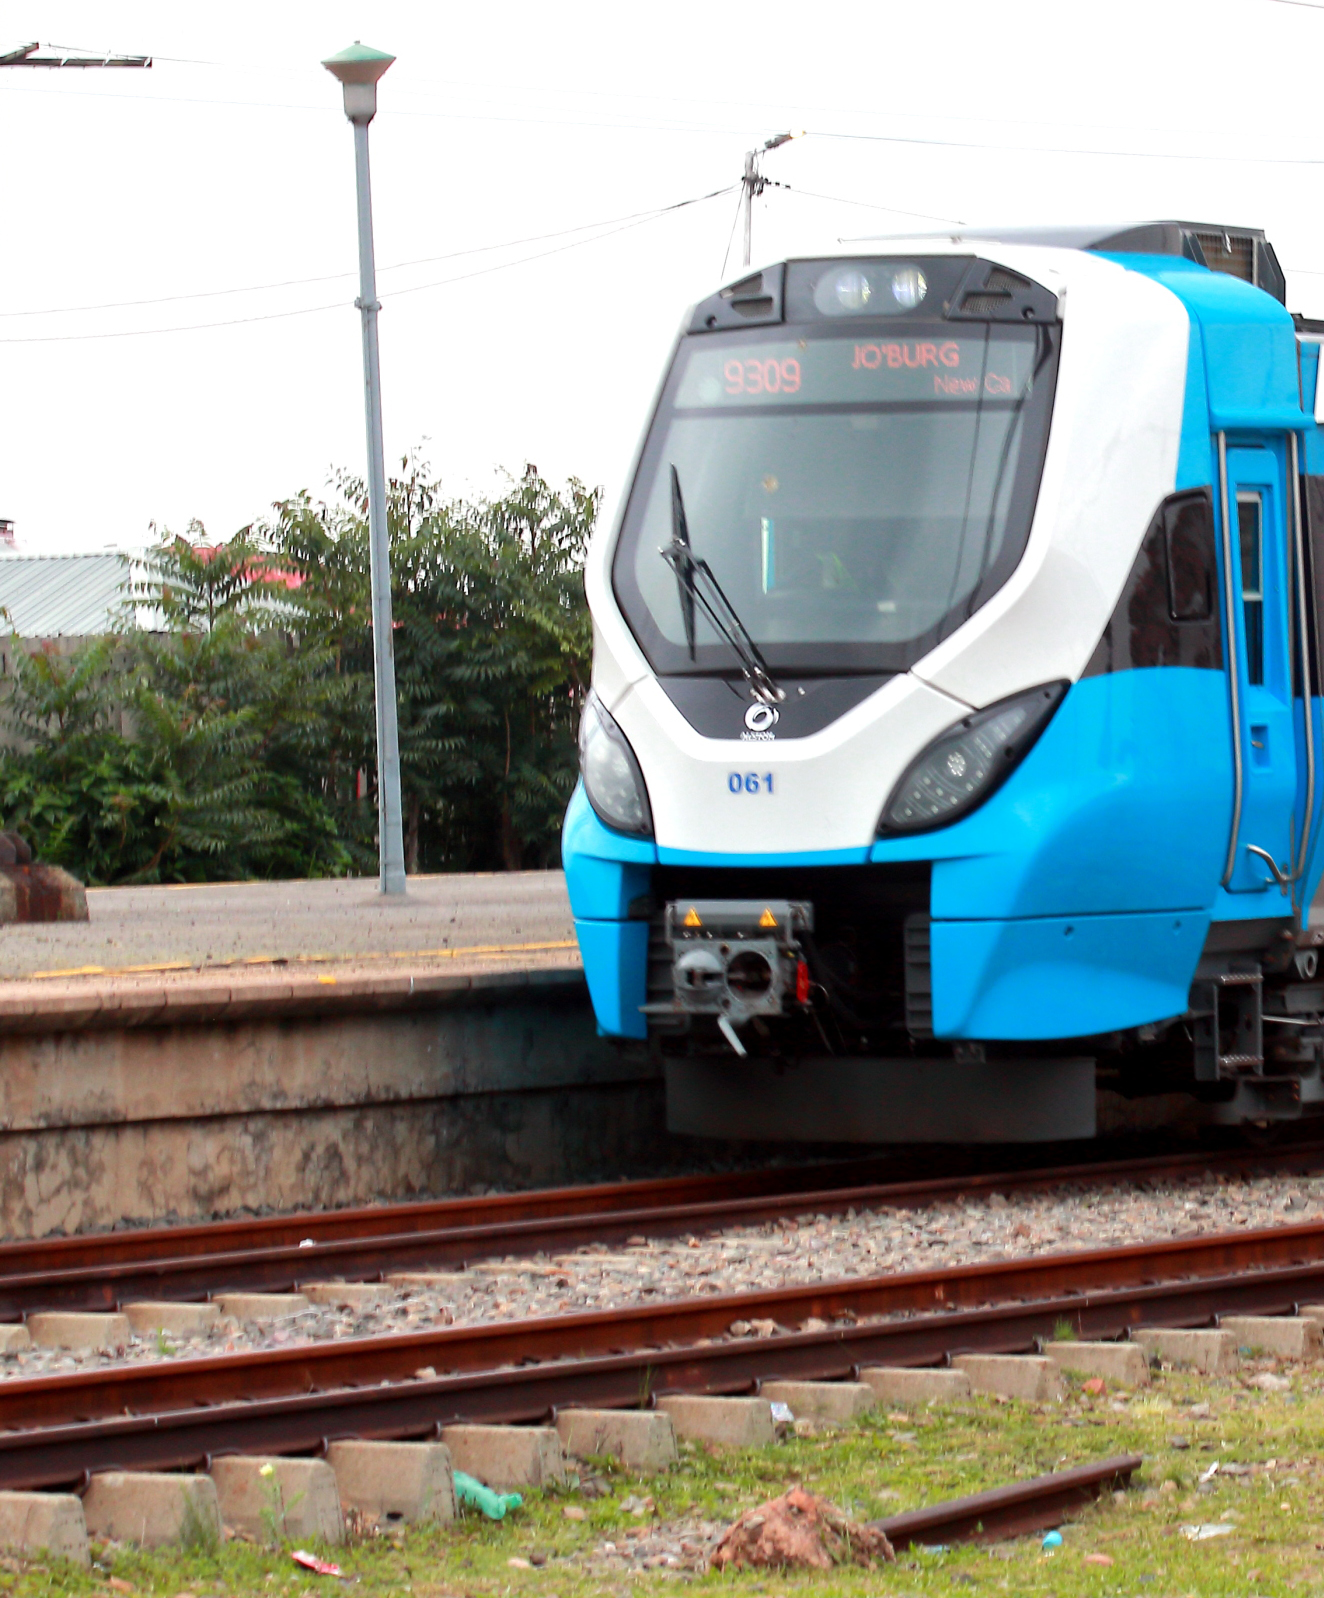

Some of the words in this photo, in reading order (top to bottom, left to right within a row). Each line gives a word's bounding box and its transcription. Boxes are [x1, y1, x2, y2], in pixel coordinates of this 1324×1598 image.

[851, 341, 960, 369] JO'BURG
[723, 357, 801, 394] 9309
[933, 373, 977, 395] New
[728, 771, 774, 795] 061
